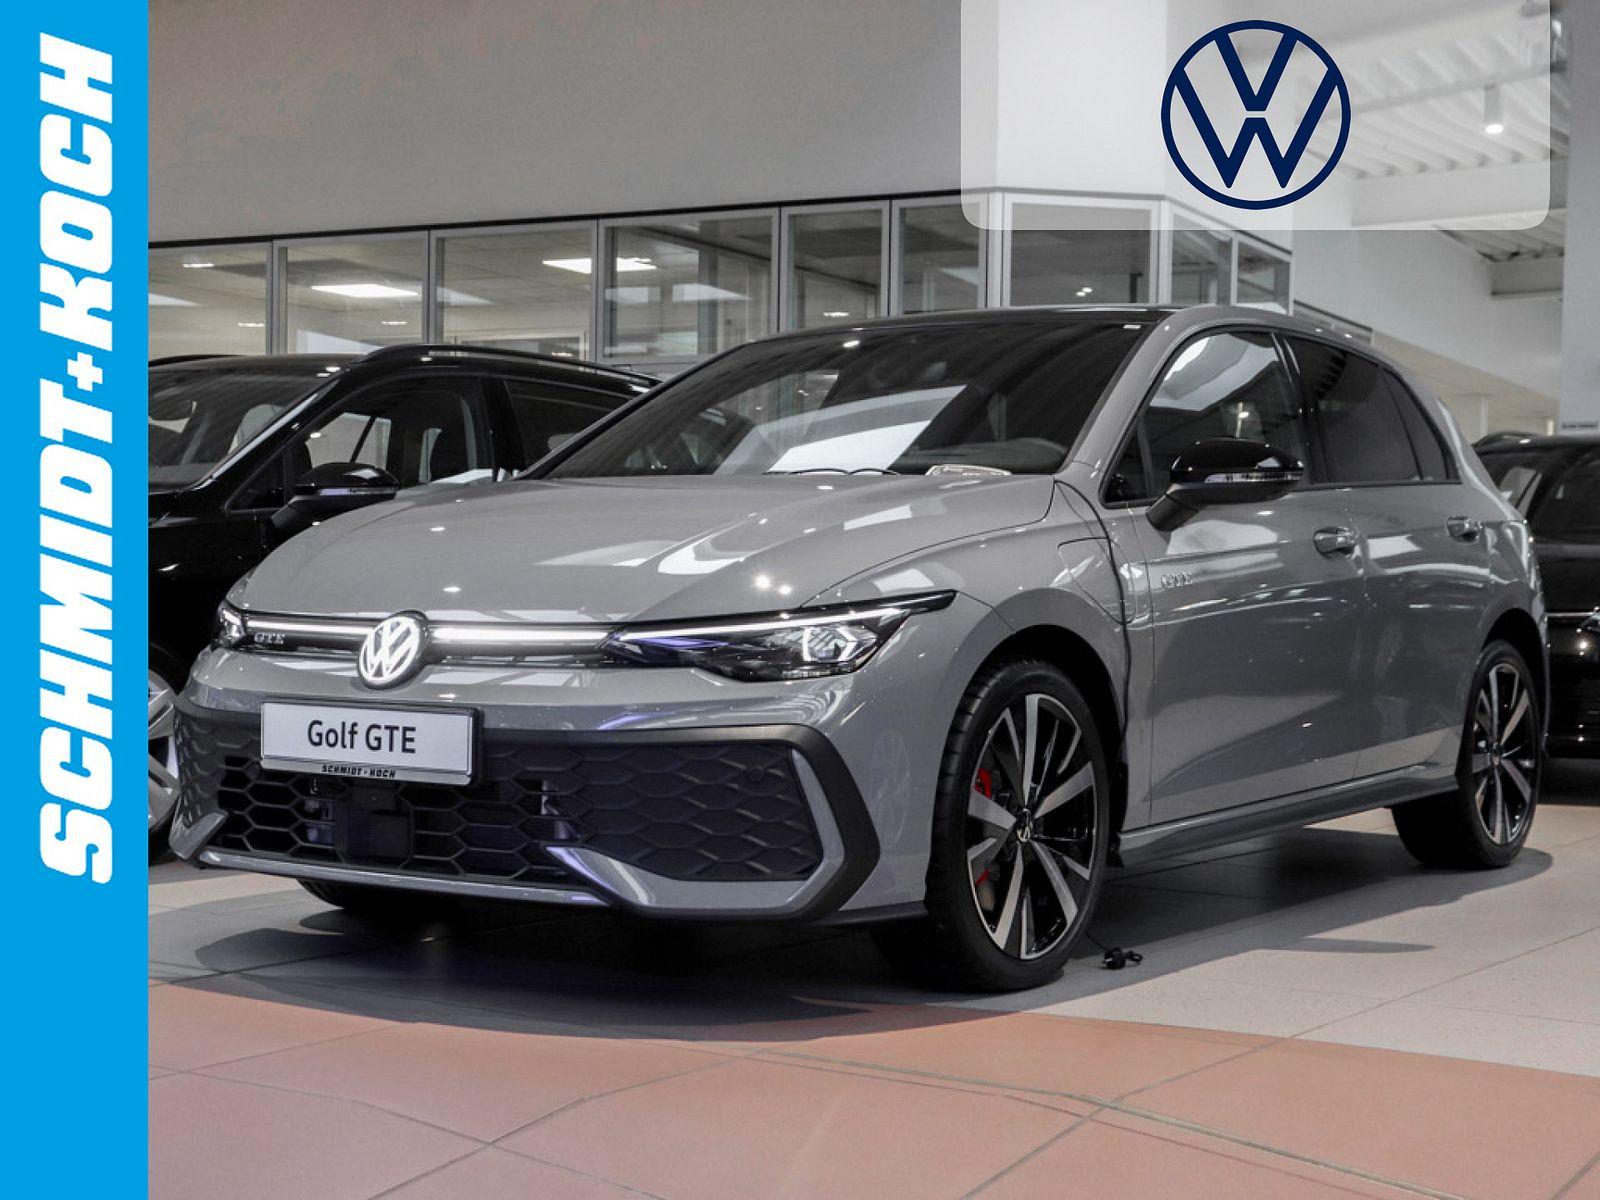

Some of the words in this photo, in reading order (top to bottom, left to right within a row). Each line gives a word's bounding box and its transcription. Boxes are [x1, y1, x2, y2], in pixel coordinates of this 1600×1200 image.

[254, 632, 285, 645] GTE
[359, 615, 421, 684] VW
[307, 719, 358, 748] Golf
[365, 723, 416, 754] GTE
